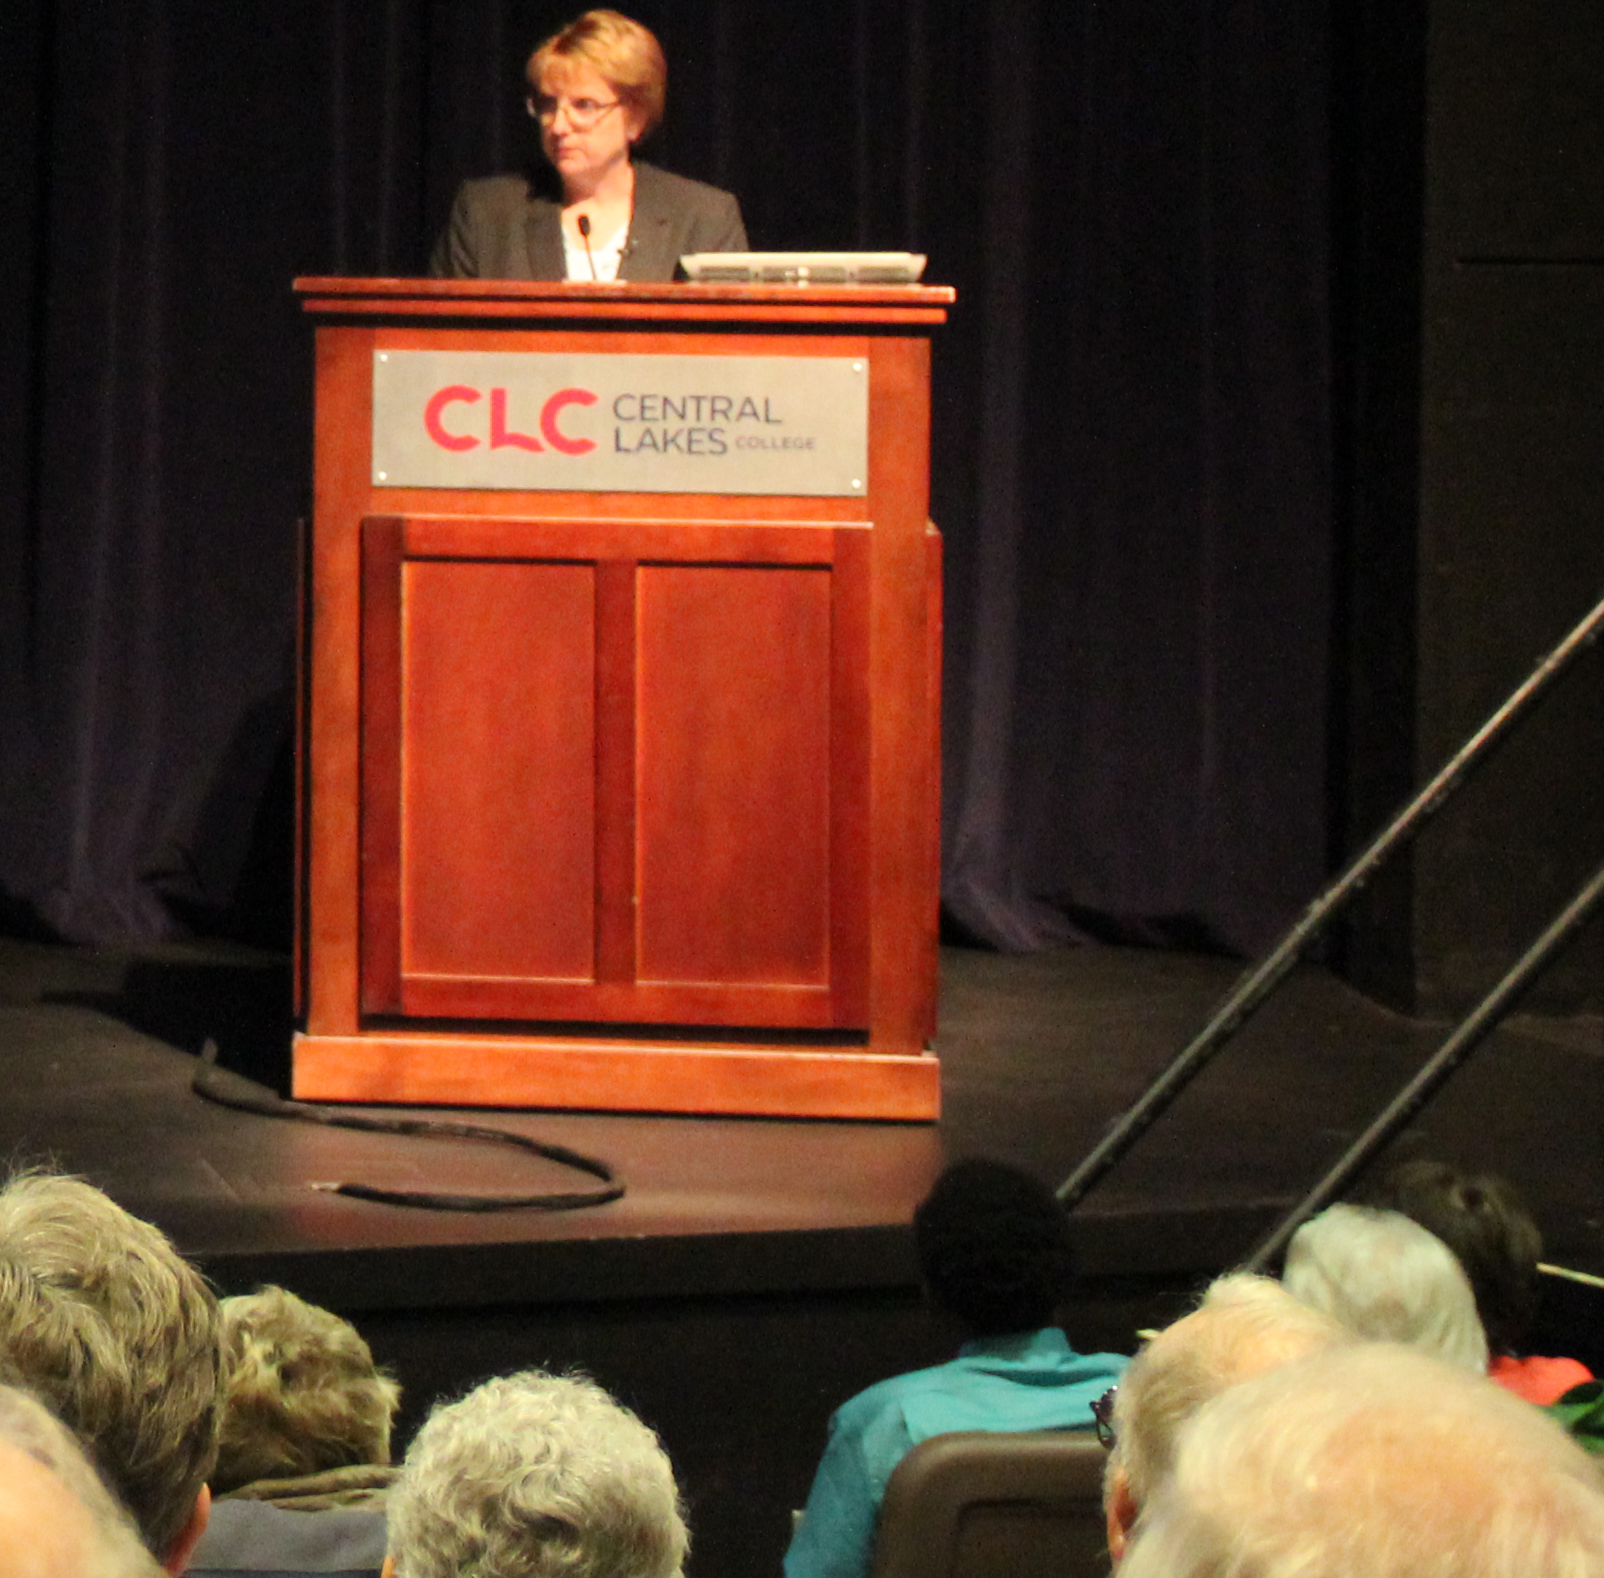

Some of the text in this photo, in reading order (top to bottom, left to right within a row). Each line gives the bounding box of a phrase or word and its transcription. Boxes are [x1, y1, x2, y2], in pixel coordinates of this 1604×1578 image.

[423, 384, 599, 457] CLC
[612, 393, 783, 425] CENTRAL
[613, 427, 818, 456] LAKES COLLEGE
